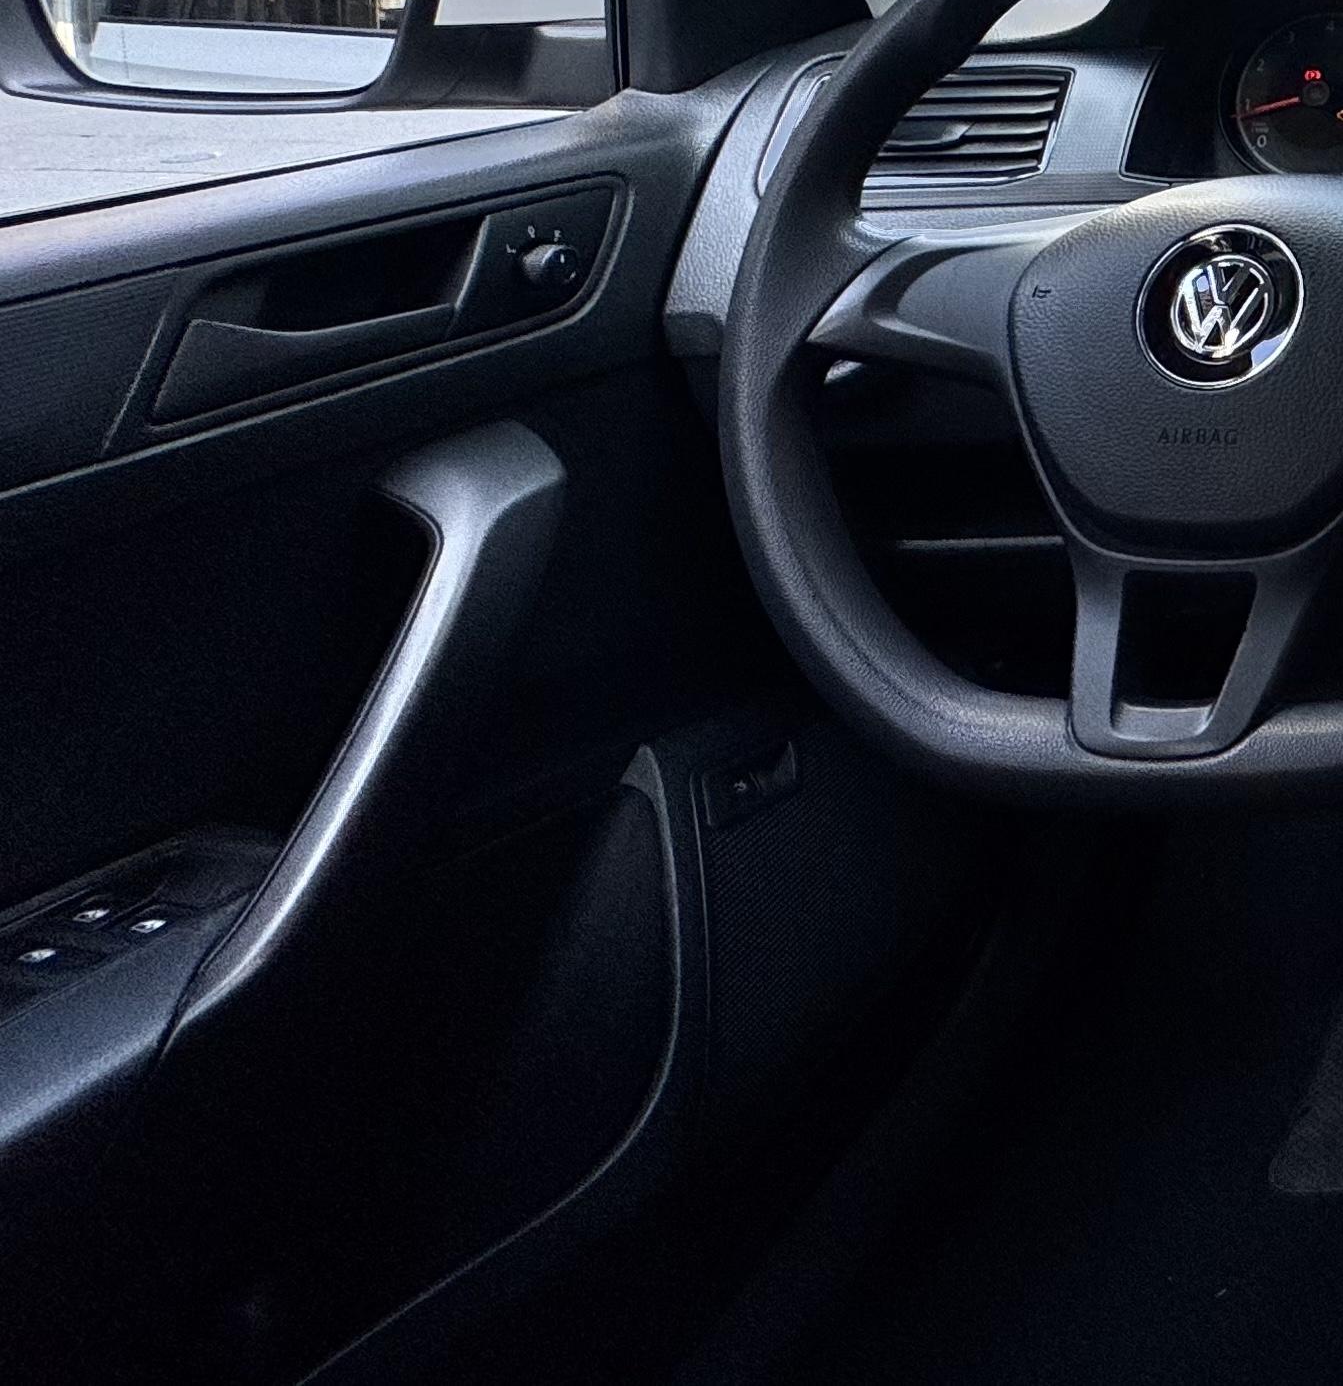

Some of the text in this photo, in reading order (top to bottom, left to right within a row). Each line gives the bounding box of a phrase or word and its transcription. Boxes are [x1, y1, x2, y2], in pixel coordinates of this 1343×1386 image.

[1256, 58, 1265, 72] 2
[1256, 135, 1267, 148] 0
[1157, 427, 1237, 444] AIRBAG
